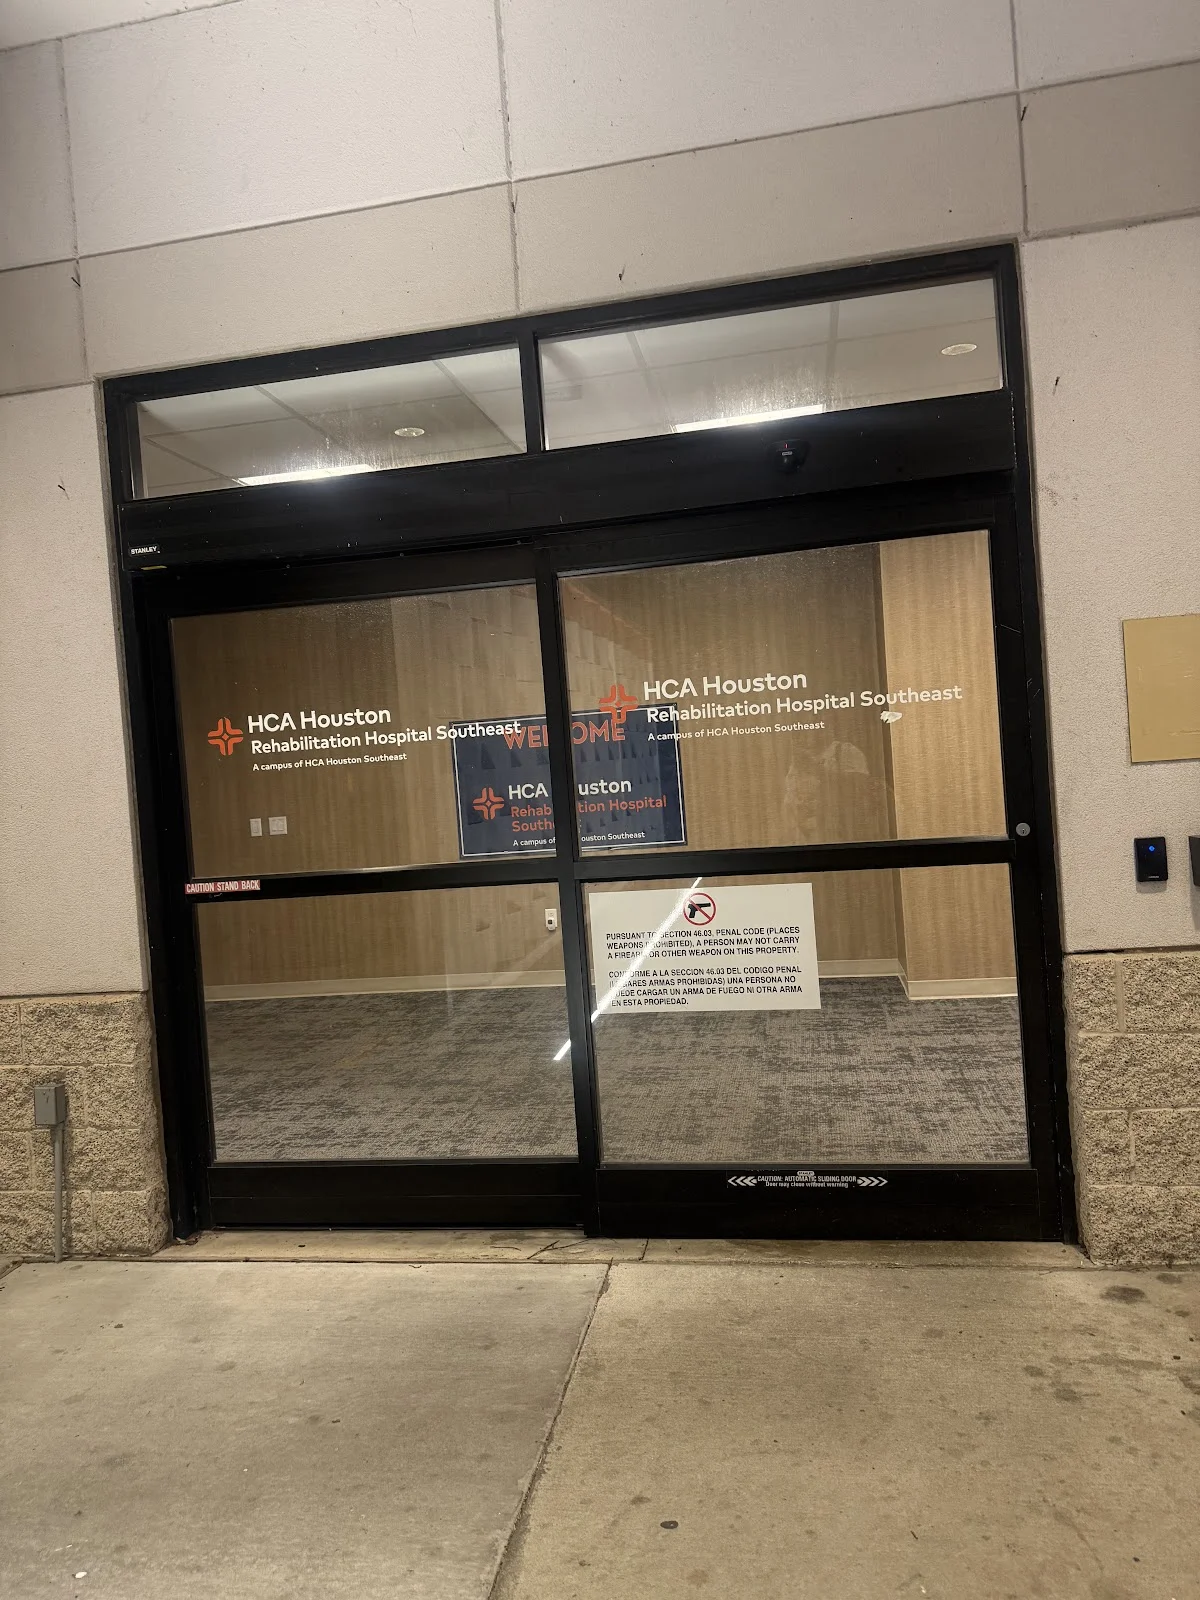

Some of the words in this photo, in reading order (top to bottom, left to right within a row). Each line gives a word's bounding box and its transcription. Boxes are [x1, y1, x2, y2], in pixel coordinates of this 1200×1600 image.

[131, 546, 157, 554] STANLEY
[644, 677, 698, 701] HCA
[703, 672, 808, 696] Houston
[646, 698, 772, 723] Rehabilitation
[776, 692, 856, 715] Hospital
[860, 685, 962, 708] Southeast
[248, 712, 296, 734] HCA
[300, 708, 391, 730] Houston
[251, 733, 361, 754] Rehabilitation
[365, 728, 432, 747] Hospital
[436, 720, 522, 740] Southeast
[504, 720, 626, 749] WELOME
[648, 732, 655, 742] A
[656, 731, 693, 742] campus
[694, 728, 705, 738] of
[706, 727, 729, 738] HCA
[731, 724, 772, 736] Houston
[774, 720, 825, 733] Southeast
[252, 763, 260, 771] A
[261, 761, 293, 772] campus
[294, 760, 303, 768] of
[304, 758, 324, 768] HCA
[326, 756, 362, 766] Houston
[364, 752, 408, 763] Southeast
[508, 783, 548, 800] HCA
[578, 779, 632, 796] uston
[610, 795, 667, 812] Hospital
[512, 818, 554, 832] South
[520, 838, 547, 847] campus
[581, 834, 606, 842] ouston
[608, 831, 646, 840] Southeast
[186, 882, 214, 892] CAUTION
[216, 881, 238, 891] STAND
[241, 880, 260, 890] BACK
[606, 932, 645, 940] PURSUANT
[716, 928, 741, 936] PENAL
[743, 928, 764, 936] CODE
[766, 926, 800, 936] (PLACES
[607, 942, 644, 950] WEAPONS
[646, 940, 694, 948] POHIBITED),
[704, 938, 734, 946] PERSON
[773, 936, 800, 944] CARRY
[608, 952, 612, 960] A
[614, 951, 645, 959] FIREAR
[688, 948, 722, 956] WEAPON
[724, 948, 734, 956] ON
[756, 946, 800, 954] PROPERTY.
[608, 970, 650, 978] CONORME
[672, 968, 704, 976] SECCION
[744, 966, 774, 974] CODIGO
[610, 980, 646, 988] (LARES
[678, 978, 726, 986] PROHIBIDAS)
[746, 976, 782, 984] PERSONA
[636, 988, 668, 996] CARGAR
[718, 986, 744, 994] FUEGO
[746, 986, 754, 994] NI
[624, 998, 642, 1006] ESTA
[644, 998, 688, 1006] PROPIEDAD.
